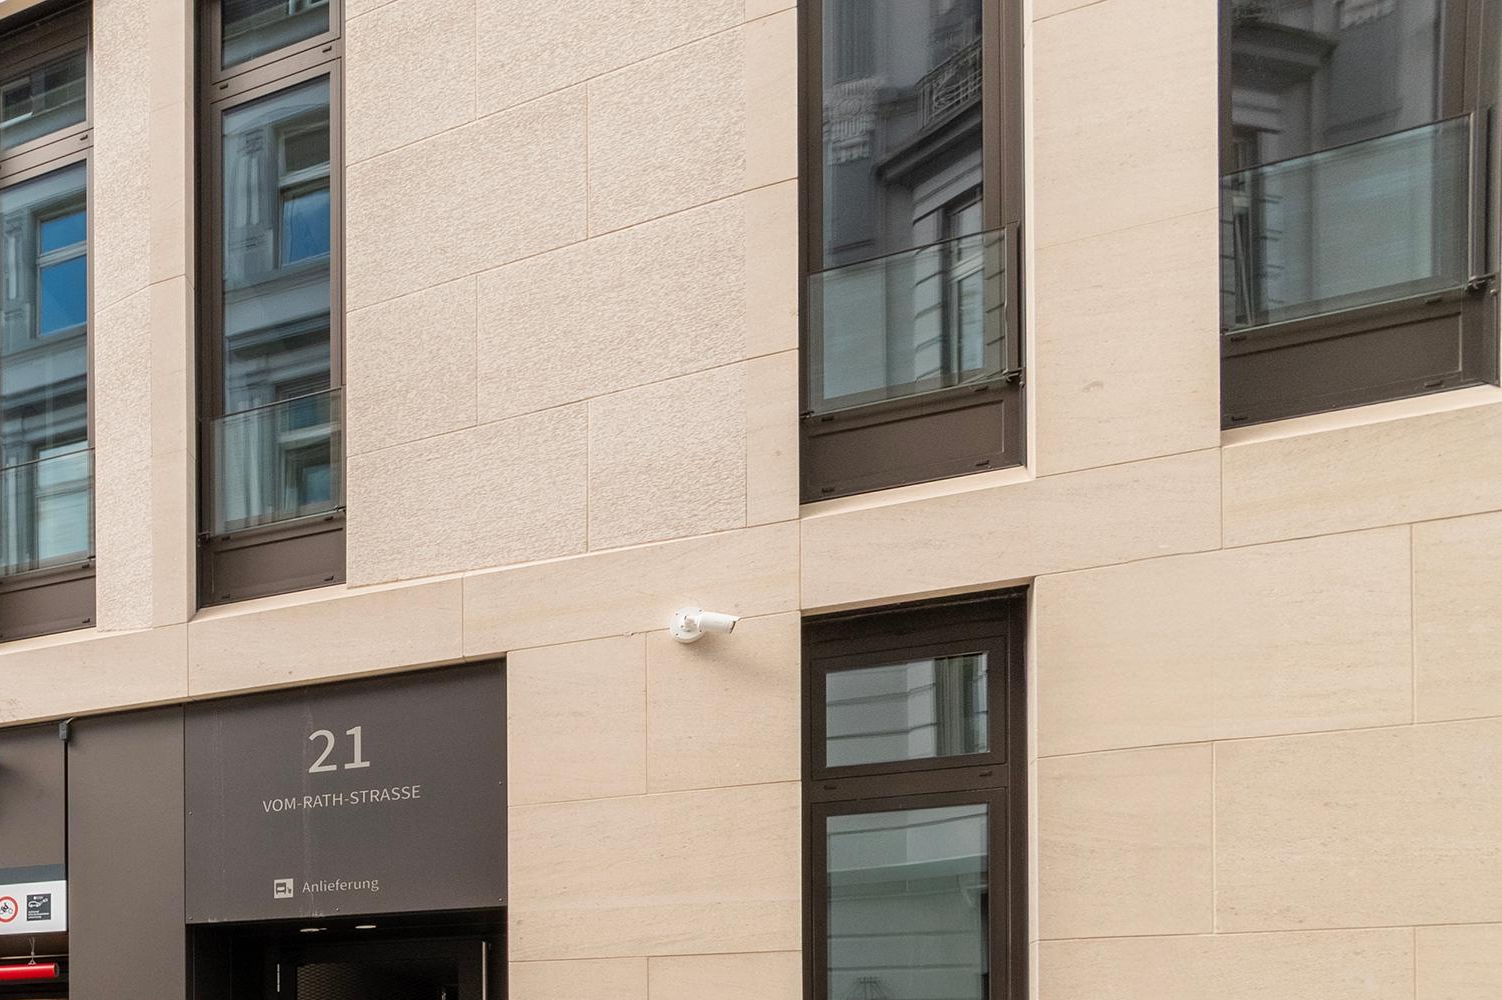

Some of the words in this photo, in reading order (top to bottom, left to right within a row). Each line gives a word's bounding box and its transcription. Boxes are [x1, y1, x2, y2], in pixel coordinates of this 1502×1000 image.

[308, 726, 371, 774] 21
[262, 785, 421, 813] VOM-RATH-STRASSE
[302, 878, 380, 893] Anlieferung
